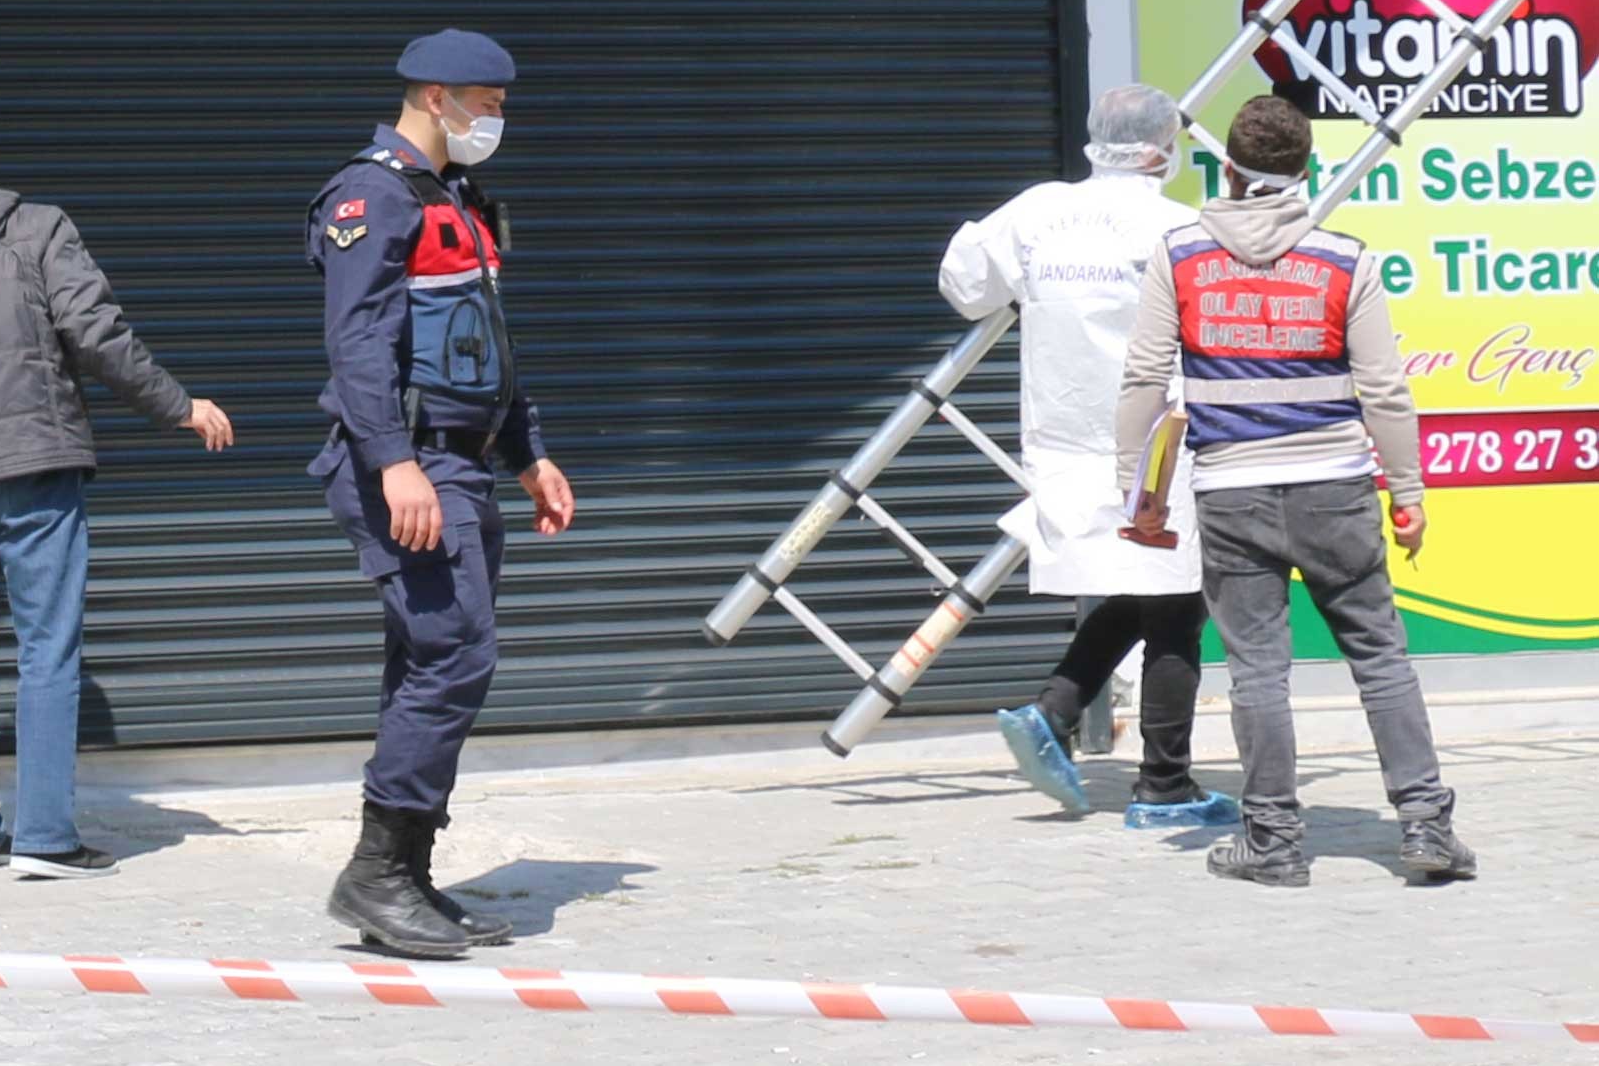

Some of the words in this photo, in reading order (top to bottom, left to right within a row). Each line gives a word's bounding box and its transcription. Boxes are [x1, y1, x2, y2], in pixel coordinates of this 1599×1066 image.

[1421, 147, 1596, 201] Sebze
[1038, 263, 1125, 284] JANDARMA
[1433, 238, 1599, 293] Ticar
[1200, 291, 1263, 317] OLAY
[1268, 293, 1326, 321] YERİ
[1199, 318, 1327, 352] İNCELEME
[1467, 325, 1596, 393] Genç
[1426, 429, 1504, 475] 278
[1512, 427, 1563, 473] 27
